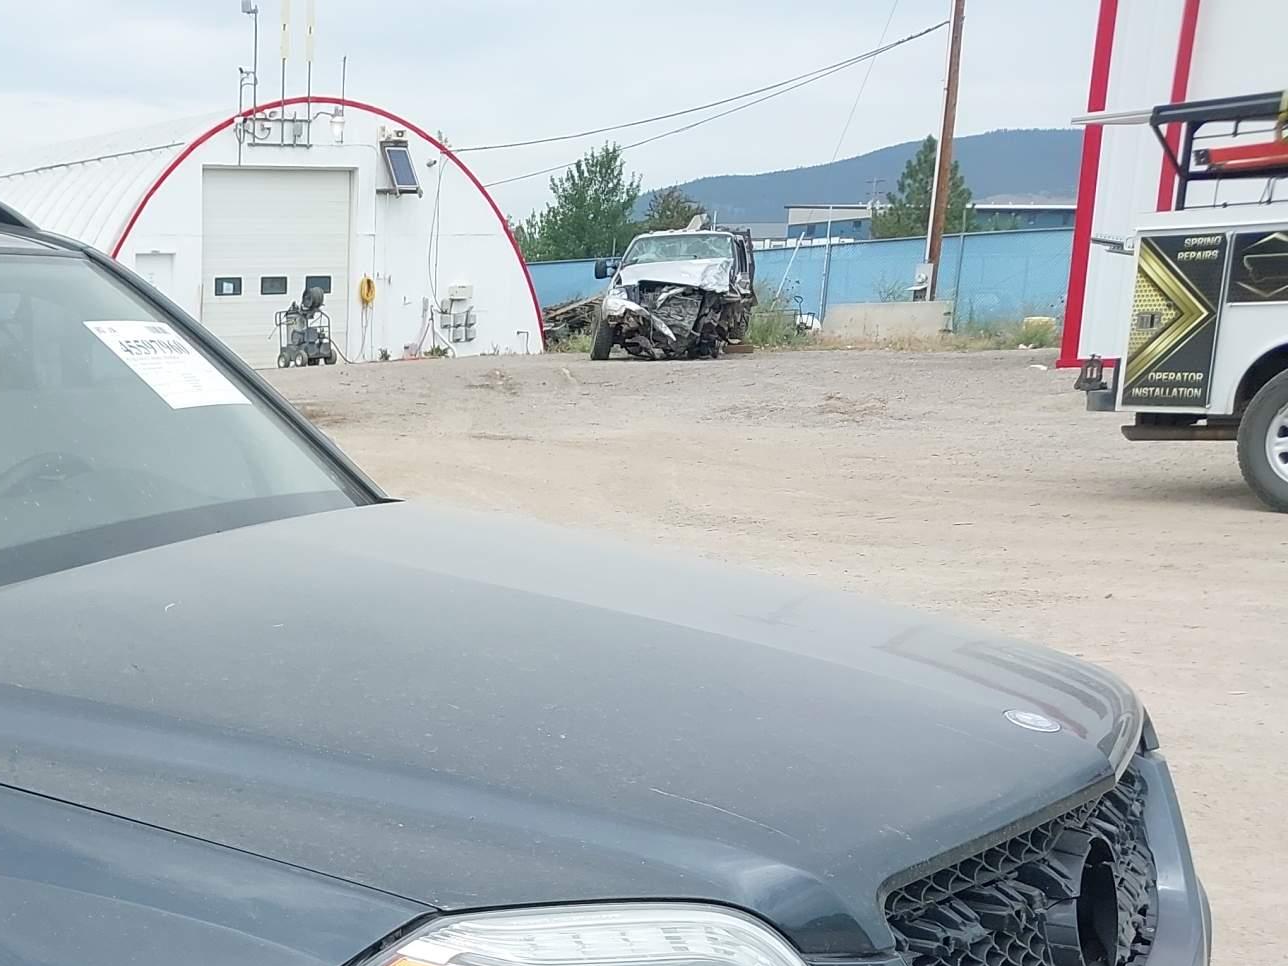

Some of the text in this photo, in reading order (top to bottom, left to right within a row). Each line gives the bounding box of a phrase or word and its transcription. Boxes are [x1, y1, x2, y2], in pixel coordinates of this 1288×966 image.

[1184, 235, 1222, 247] SPRING
[1177, 249, 1219, 260] REPAIRS
[118, 339, 191, 356] 45597960
[1148, 372, 1204, 383] OPERATOR
[1131, 386, 1202, 398] INSTALLATION
